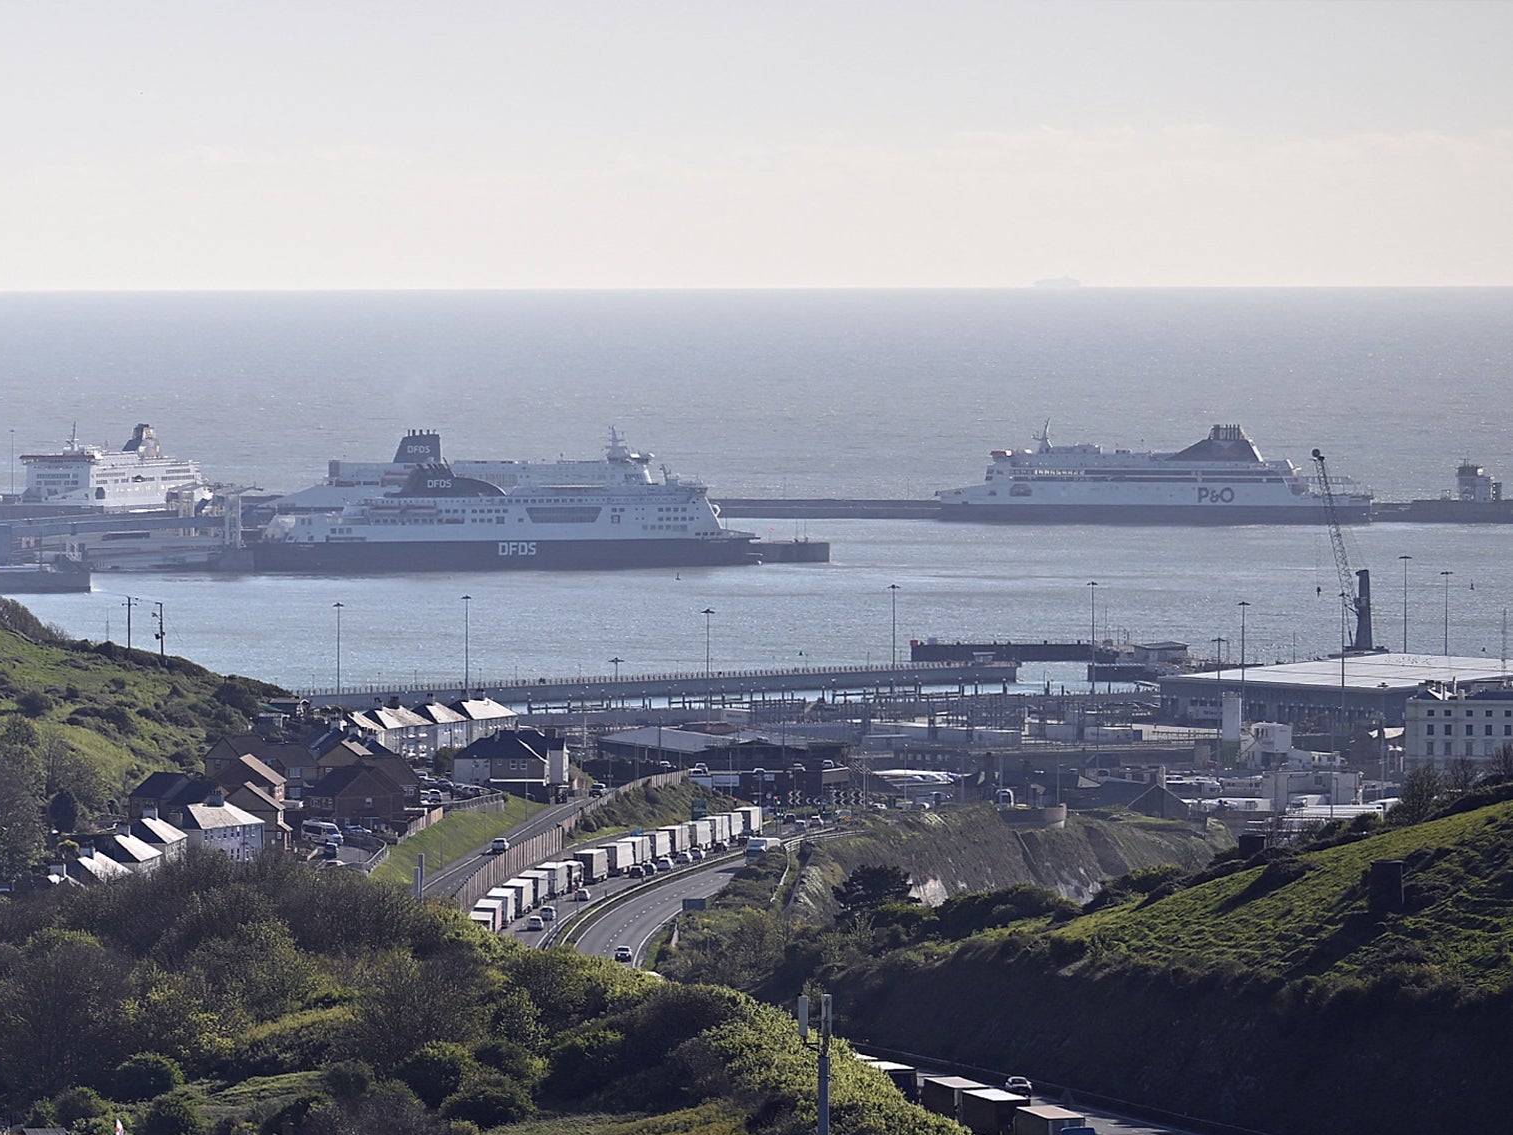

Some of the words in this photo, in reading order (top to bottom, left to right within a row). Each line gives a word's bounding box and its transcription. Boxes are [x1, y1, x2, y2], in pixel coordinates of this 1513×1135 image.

[407, 445, 431, 454] DFDS
[427, 479, 452, 489] DFDS
[1198, 487, 1235, 503] P&O
[498, 542, 537, 556] DFDS
